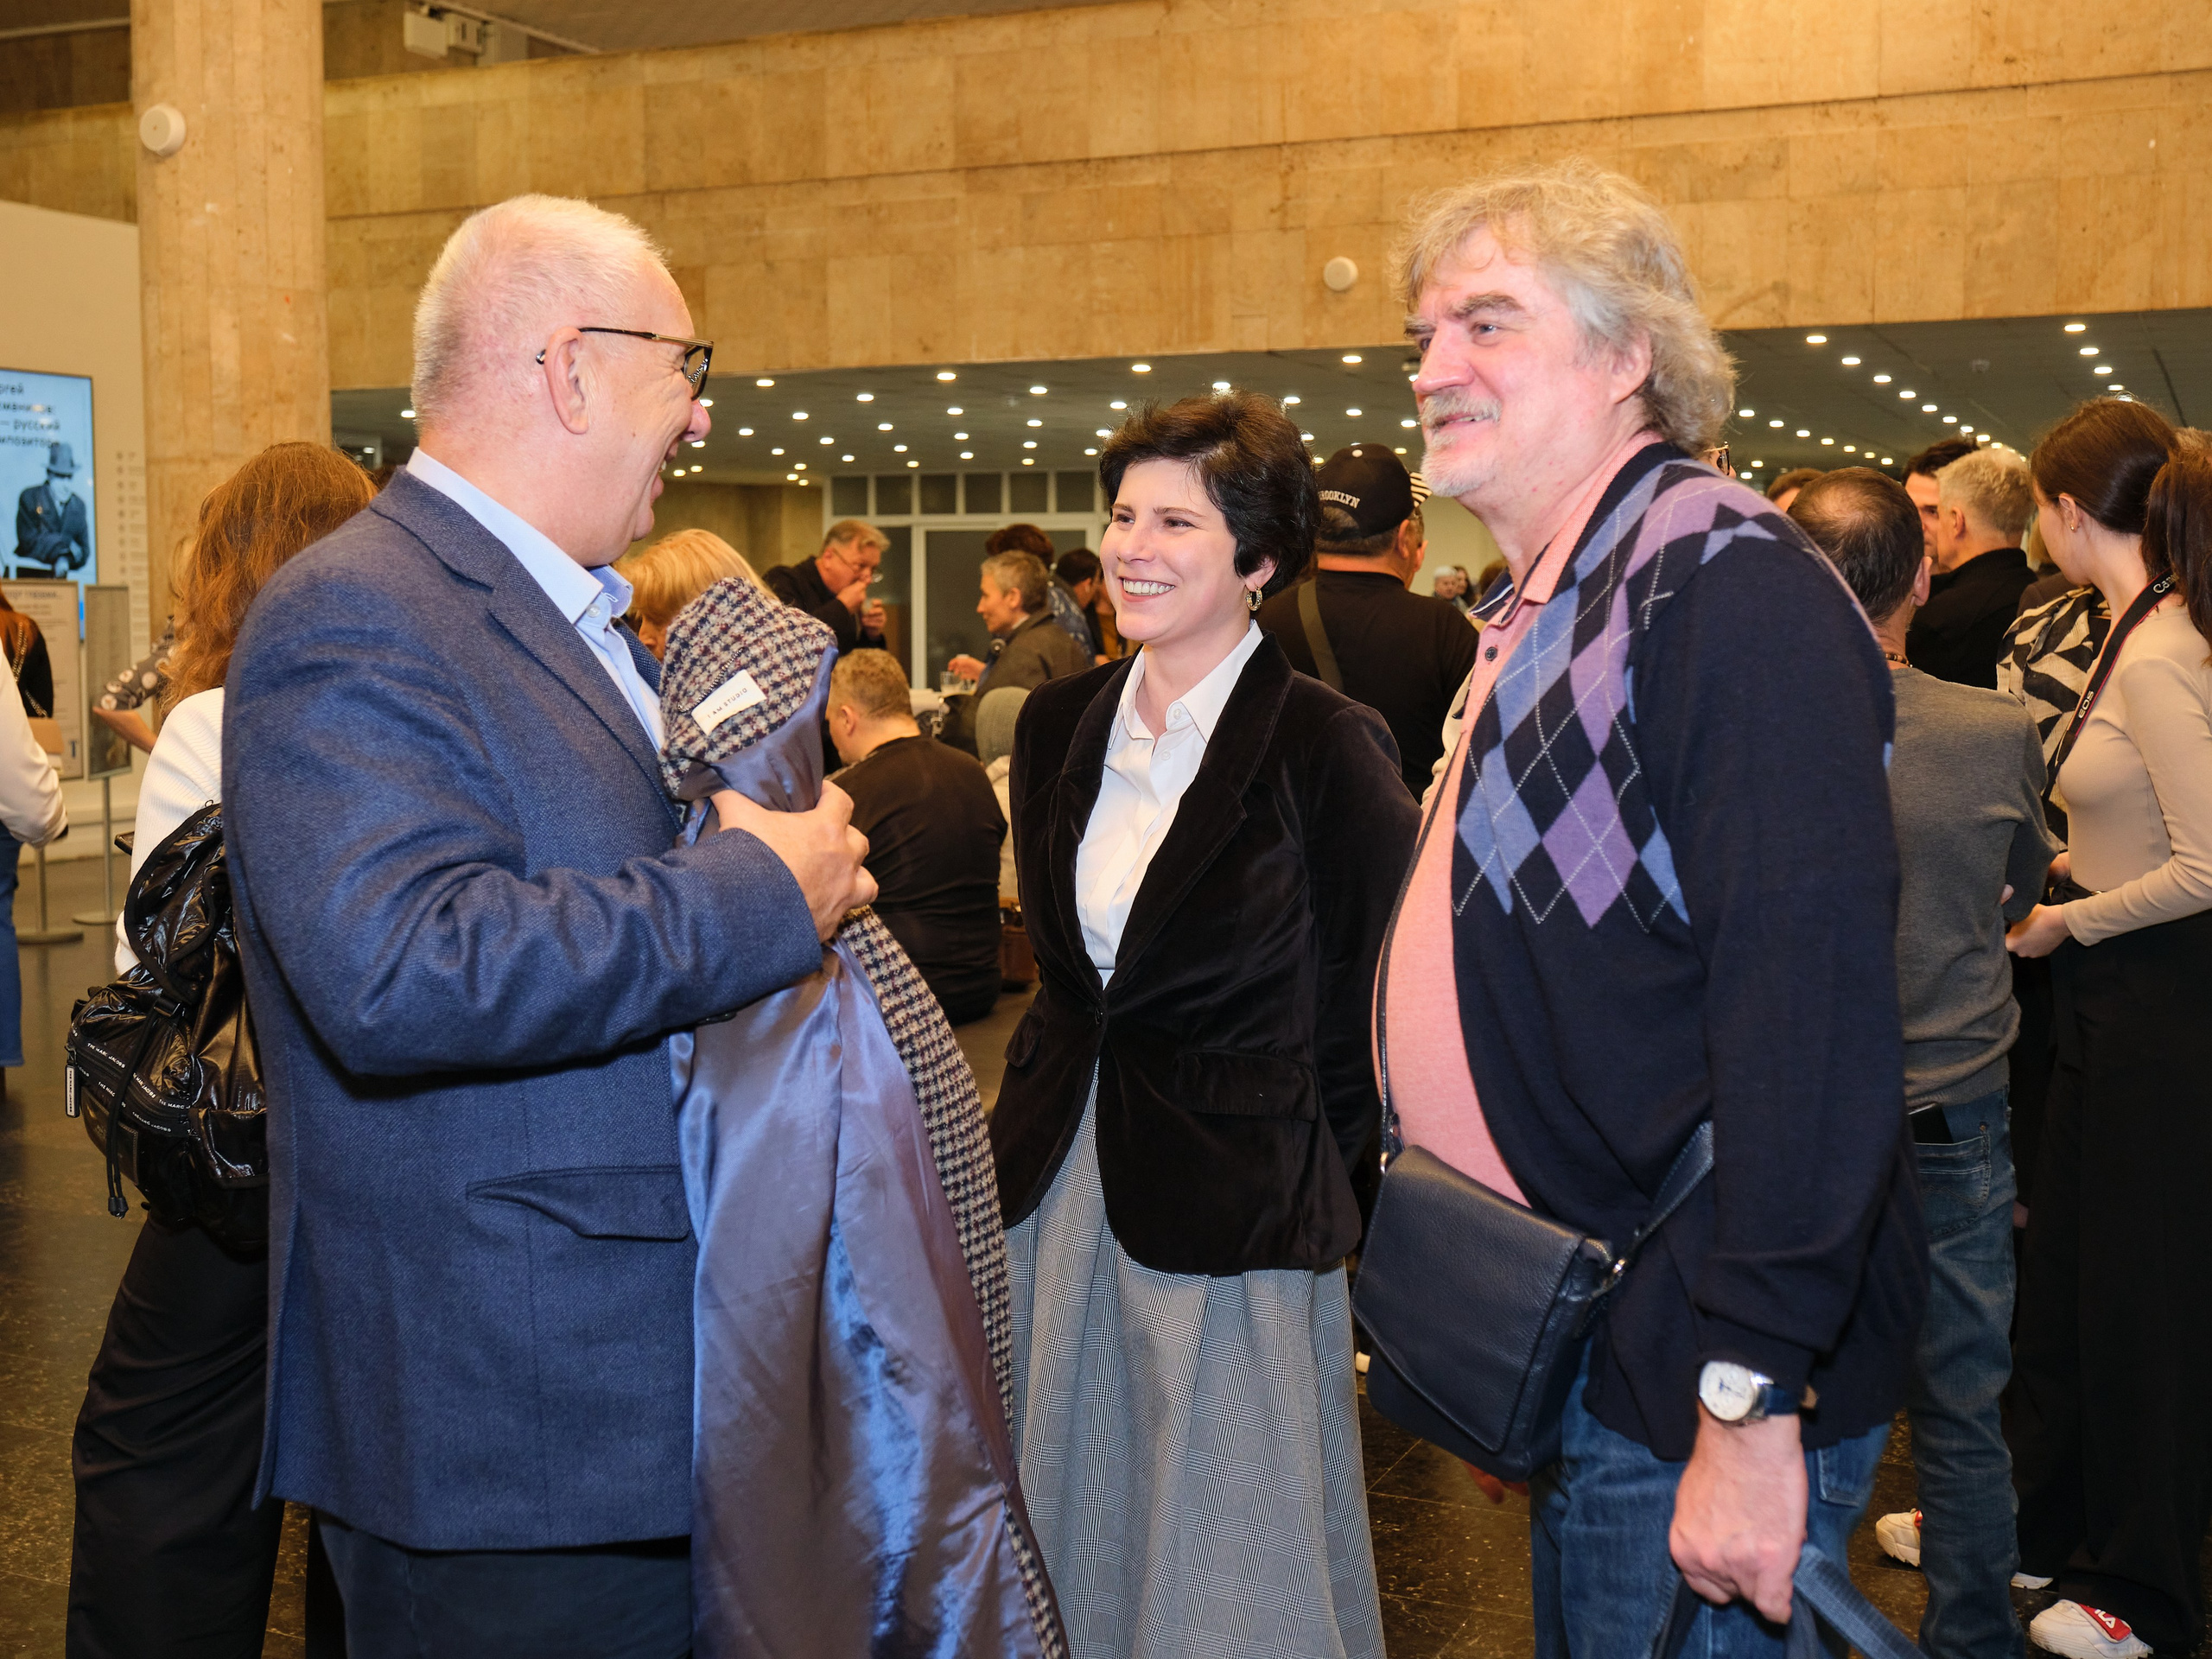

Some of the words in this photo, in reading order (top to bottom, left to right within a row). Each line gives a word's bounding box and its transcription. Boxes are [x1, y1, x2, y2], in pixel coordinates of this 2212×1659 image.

[1318, 490, 1361, 509] ROOKLYN
[723, 687, 748, 707] STUDIO
[2078, 690, 2094, 719] EOS
[2094, 1608, 2116, 1629] ILA
